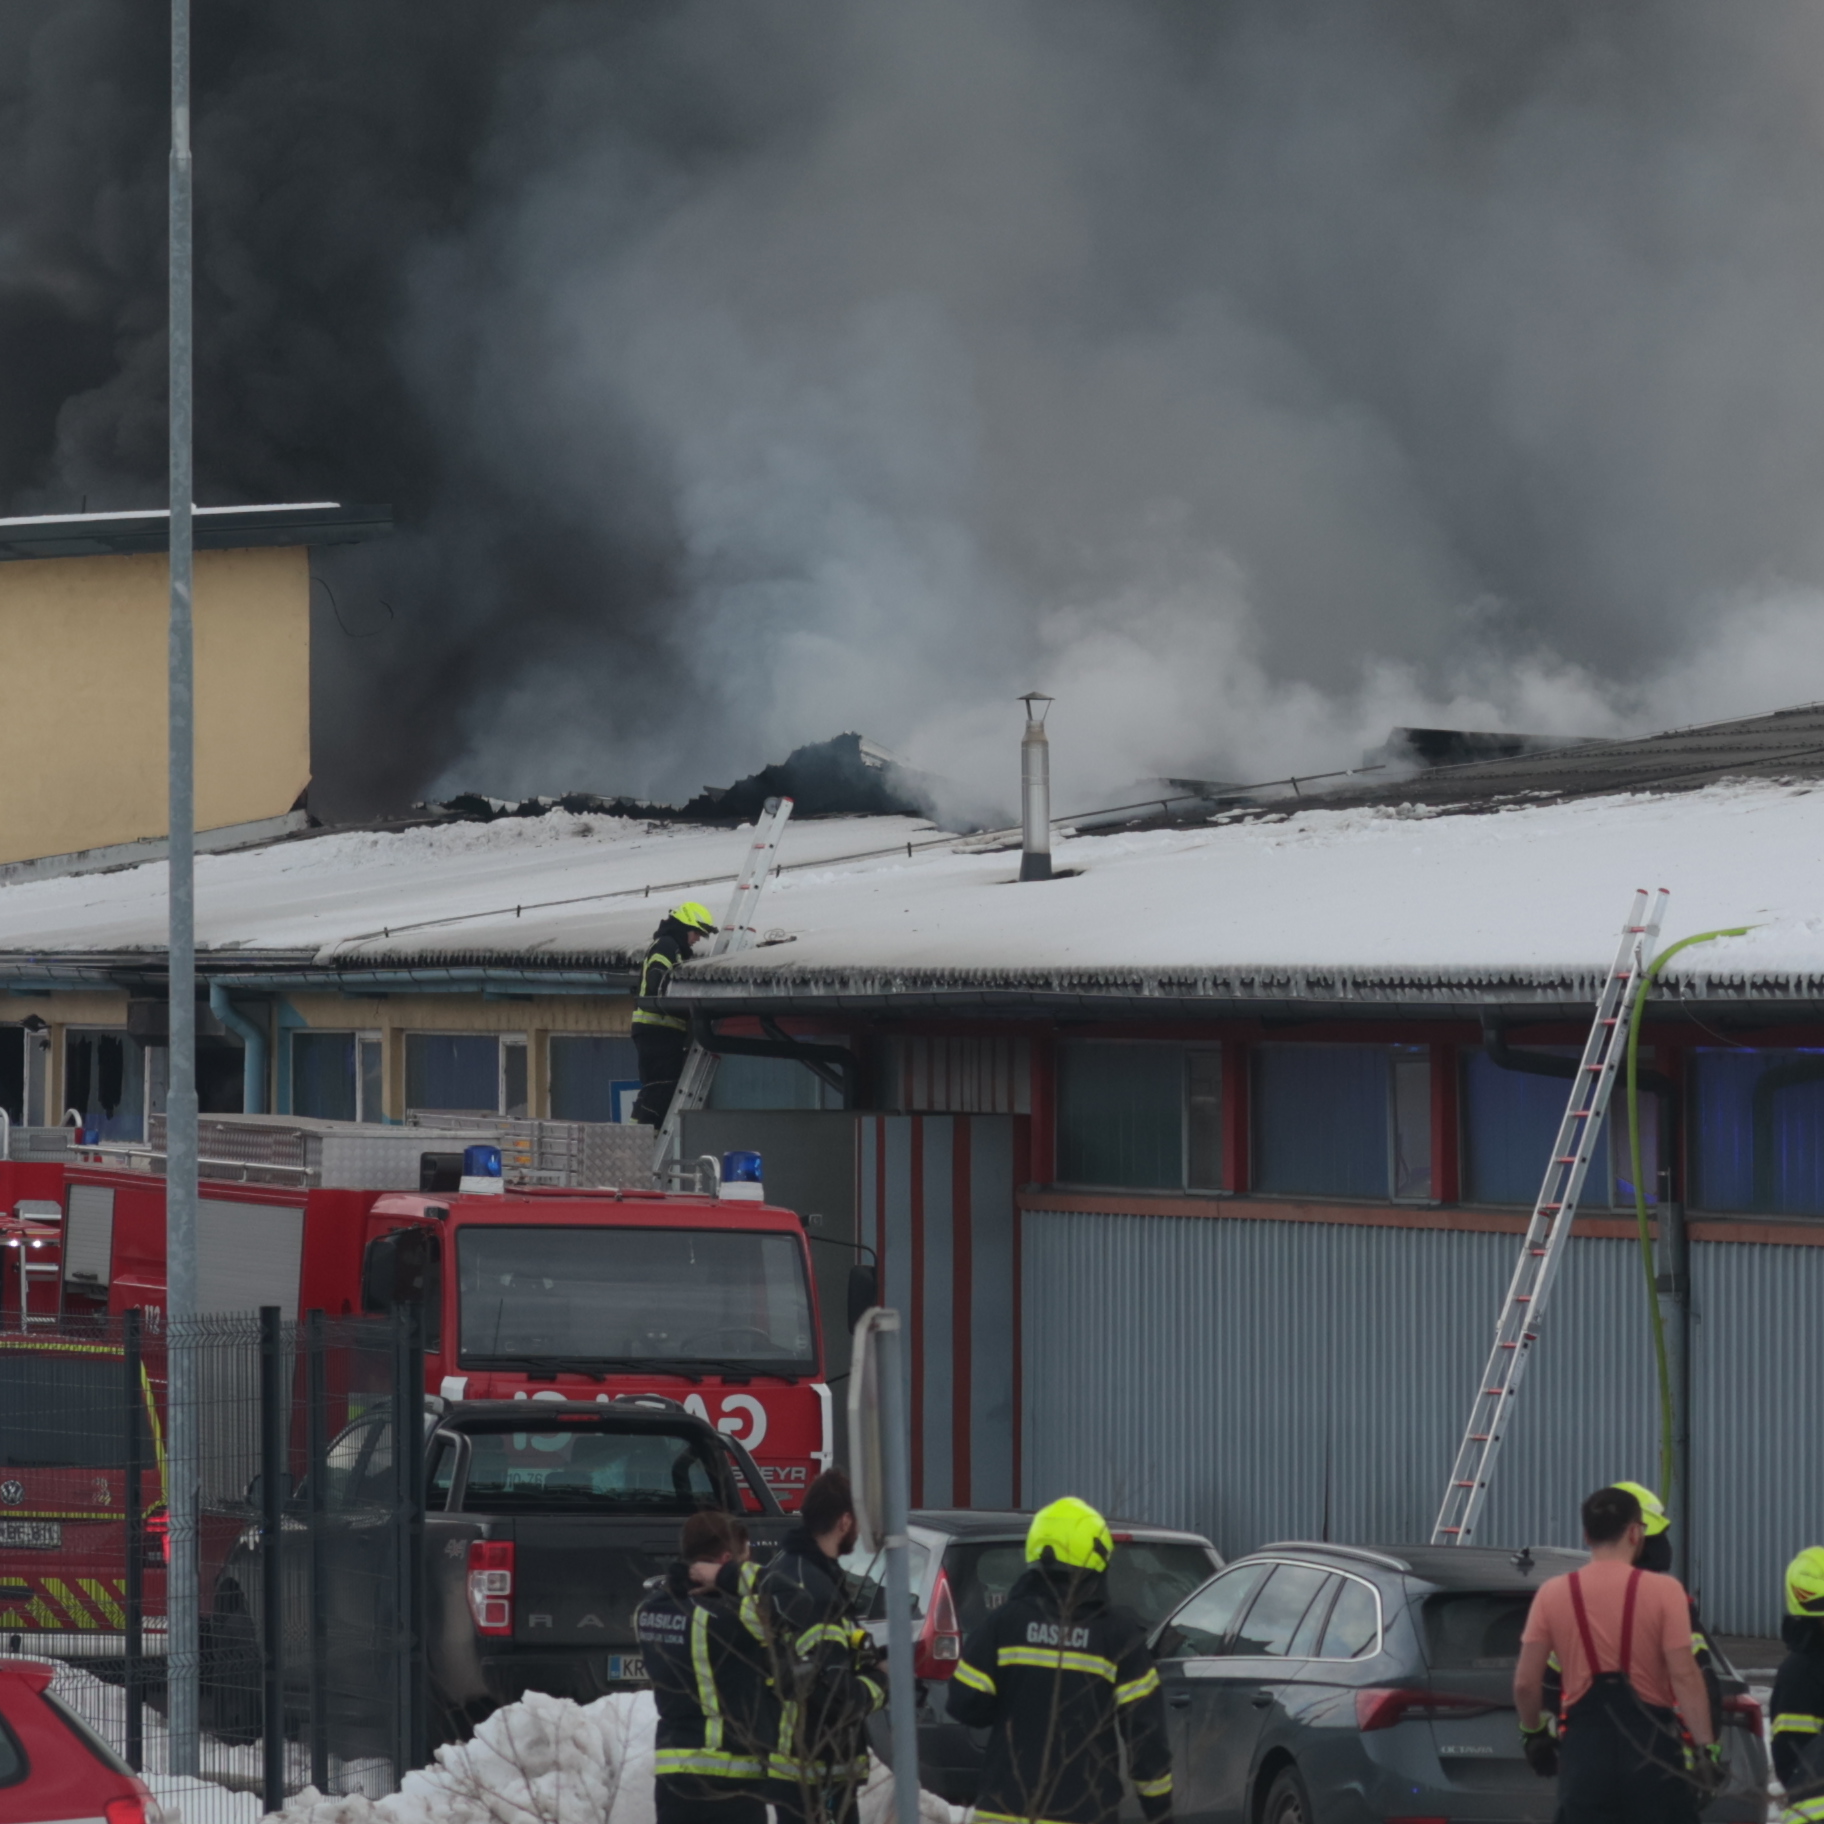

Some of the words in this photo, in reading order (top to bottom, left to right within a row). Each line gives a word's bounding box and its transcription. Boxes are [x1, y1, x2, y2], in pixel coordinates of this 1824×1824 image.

[144, 1304, 160, 1334] 112
[731, 1466, 807, 1481] SEYR
[639, 1611, 687, 1631] GASILCI
[623, 1659, 644, 1677] KR
